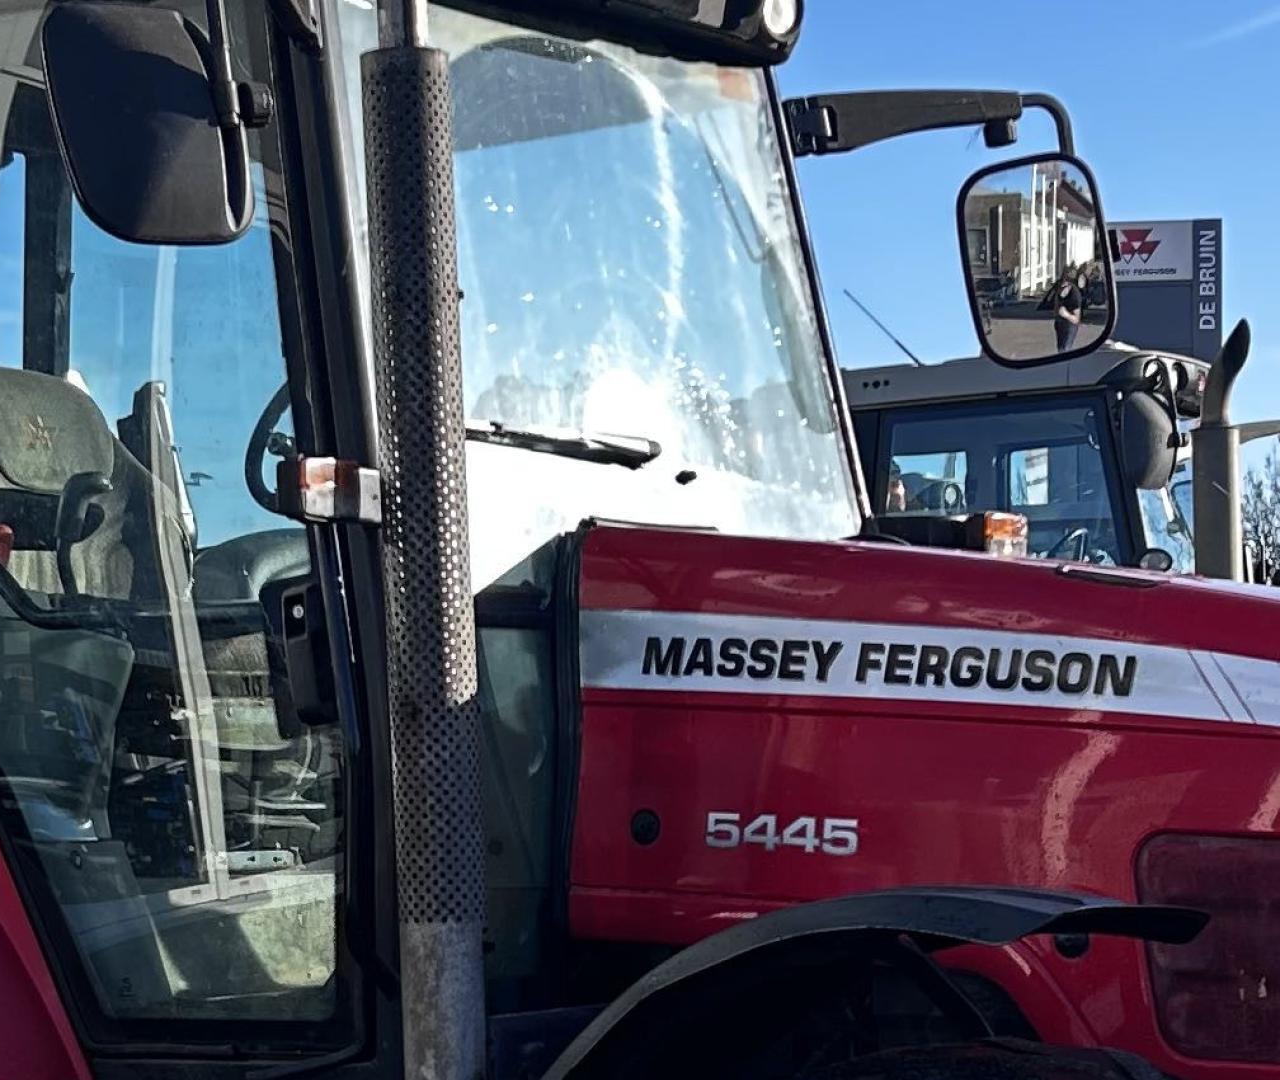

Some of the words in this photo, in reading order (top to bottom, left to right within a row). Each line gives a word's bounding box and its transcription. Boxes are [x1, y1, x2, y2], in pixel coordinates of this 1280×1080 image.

[1200, 230, 1216, 296] BRUIN
[1200, 302, 1215, 329] DE
[641, 637, 844, 683] MASSEY
[854, 642, 1137, 697] FERGUSON
[706, 812, 858, 855] 5445
